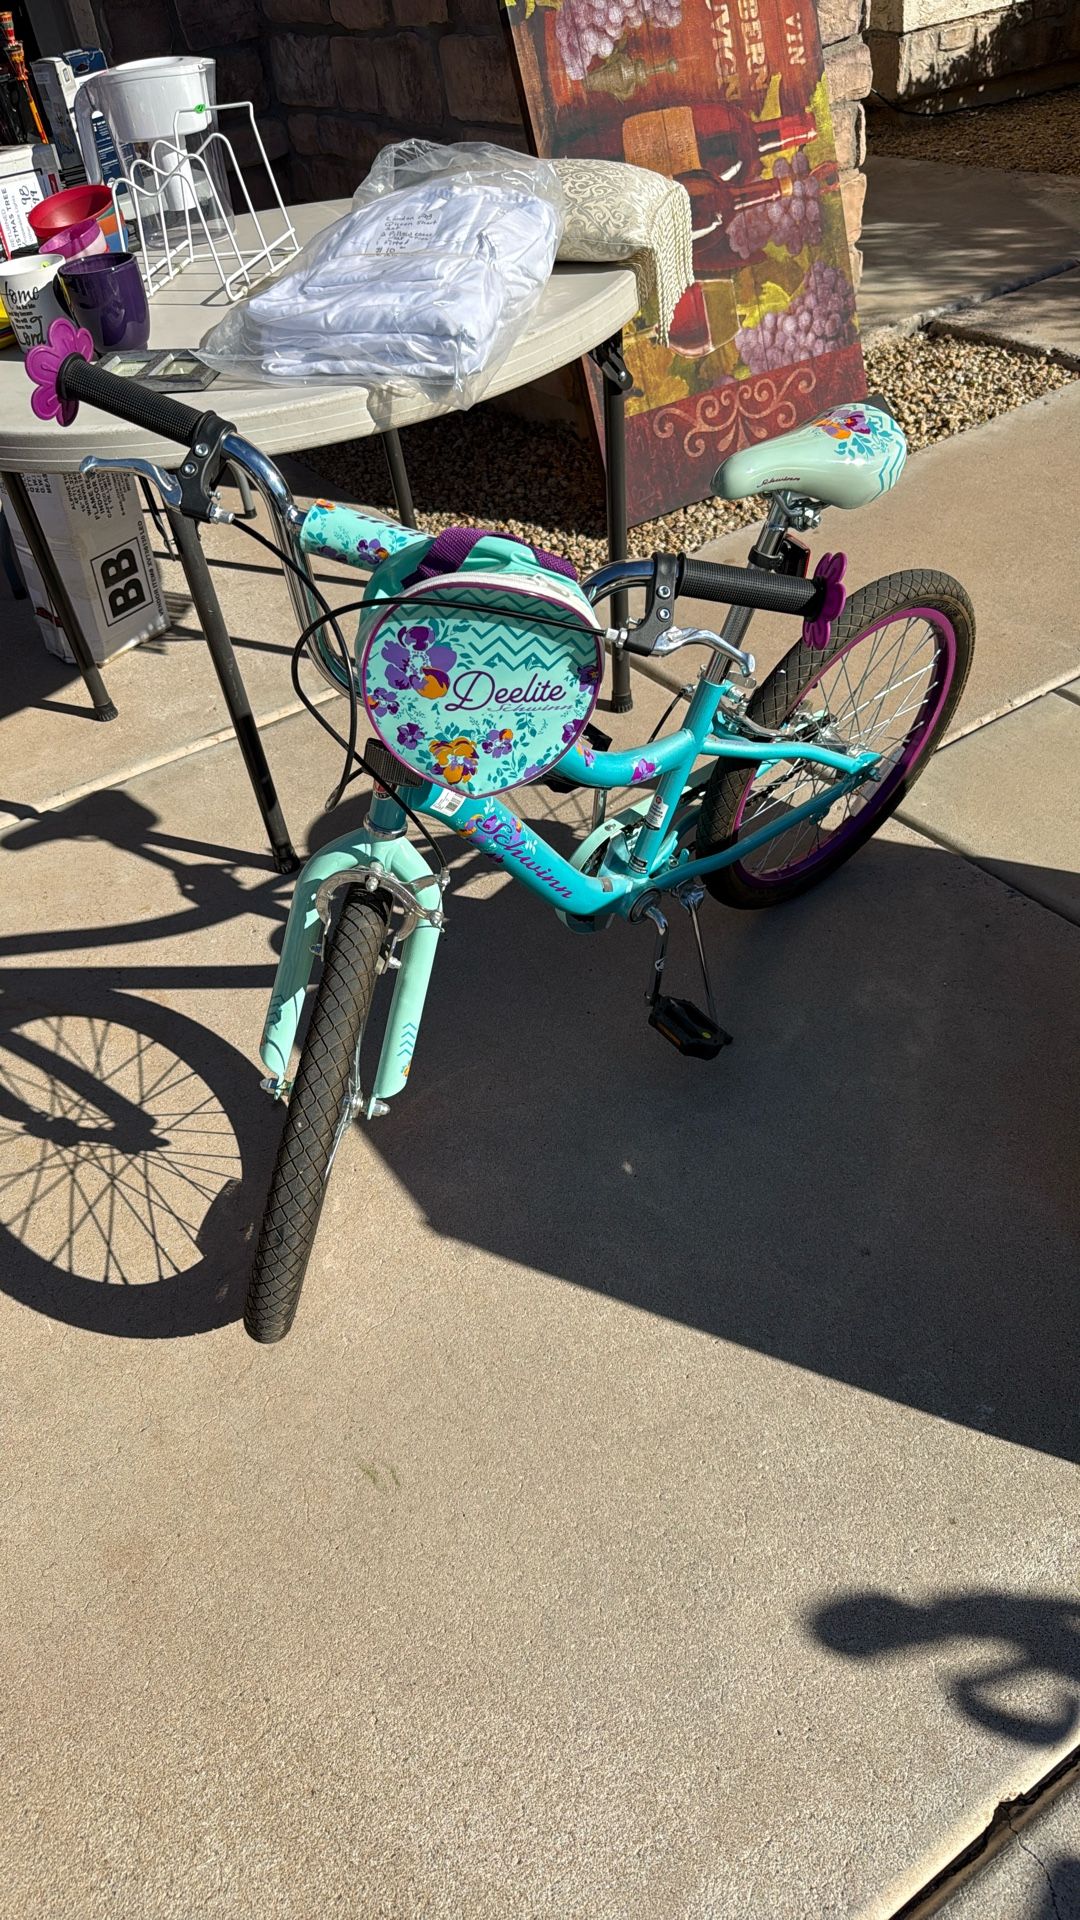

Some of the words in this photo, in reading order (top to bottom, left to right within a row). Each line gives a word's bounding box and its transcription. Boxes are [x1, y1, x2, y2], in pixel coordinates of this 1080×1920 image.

[705, 0, 741, 101] VIGN
[785, 12, 806, 65] VIN
[1, 187, 12, 211] TREE
[9, 213, 22, 247] ISTMAS
[92, 481, 105, 514] INDOOR
[100, 548, 146, 618] BB
[444, 670, 567, 711] Deelite
[487, 703, 575, 712] Schwinn
[476, 817, 574, 899] Schwinn
